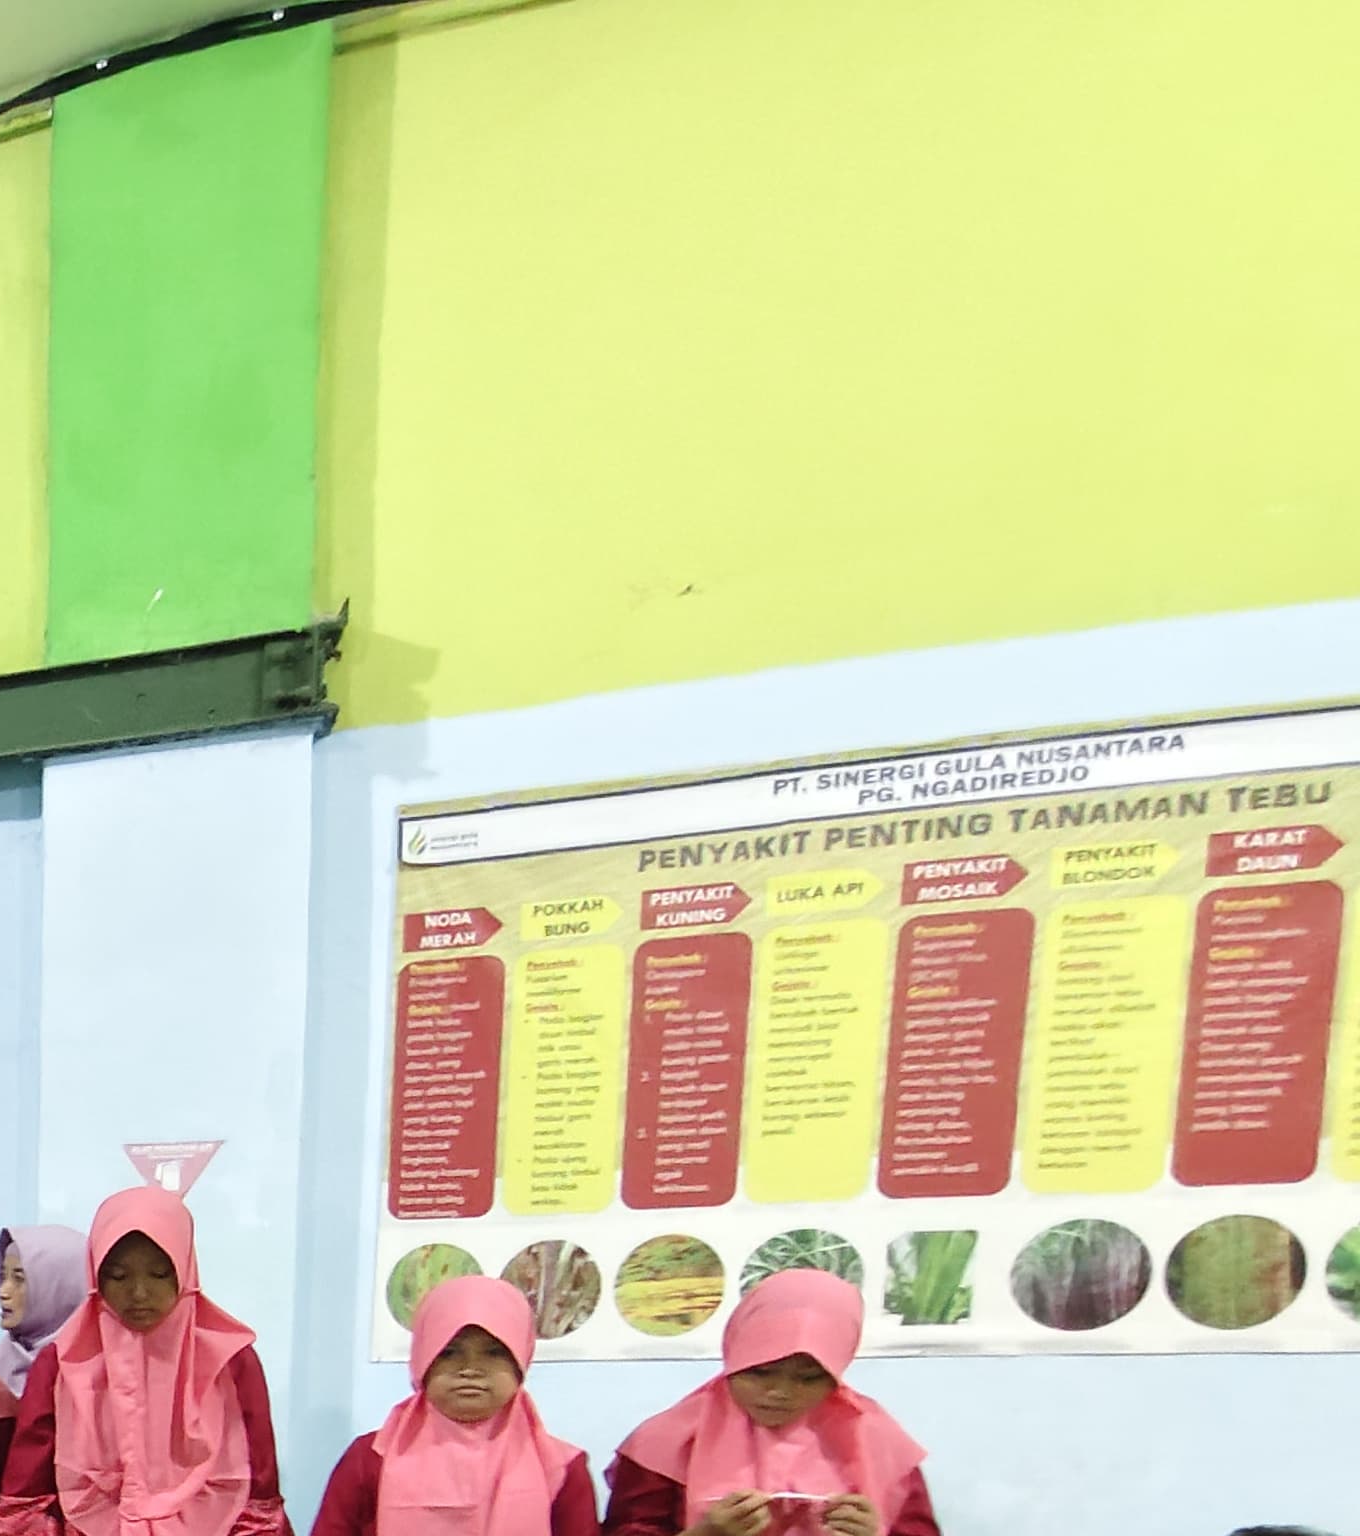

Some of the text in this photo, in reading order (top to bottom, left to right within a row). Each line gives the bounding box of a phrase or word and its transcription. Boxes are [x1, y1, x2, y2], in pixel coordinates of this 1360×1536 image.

[773, 734, 1185, 796] PT. SINERGI GULA NUSANTARA
[858, 765, 1090, 806] PG. NGADIREDJO
[638, 780, 1332, 872] PENYAKIT PENTING TANAMAN TEBU
[1233, 829, 1308, 849] KARAT
[1064, 843, 1158, 864] PENYAKIT
[1236, 853, 1302, 873] DAUN
[912, 857, 1009, 880] PENYAKIT
[1062, 866, 1156, 885] BLONDOK
[650, 885, 735, 906] PENYAKIT
[777, 882, 865, 903] LUKA API
[916, 881, 999, 902] MOSAIK
[533, 899, 603, 917] POKKAH
[655, 908, 727, 927] KUNING
[424, 911, 472, 928] NODA
[544, 921, 591, 938] BUNG
[419, 931, 476, 948] MERAH
